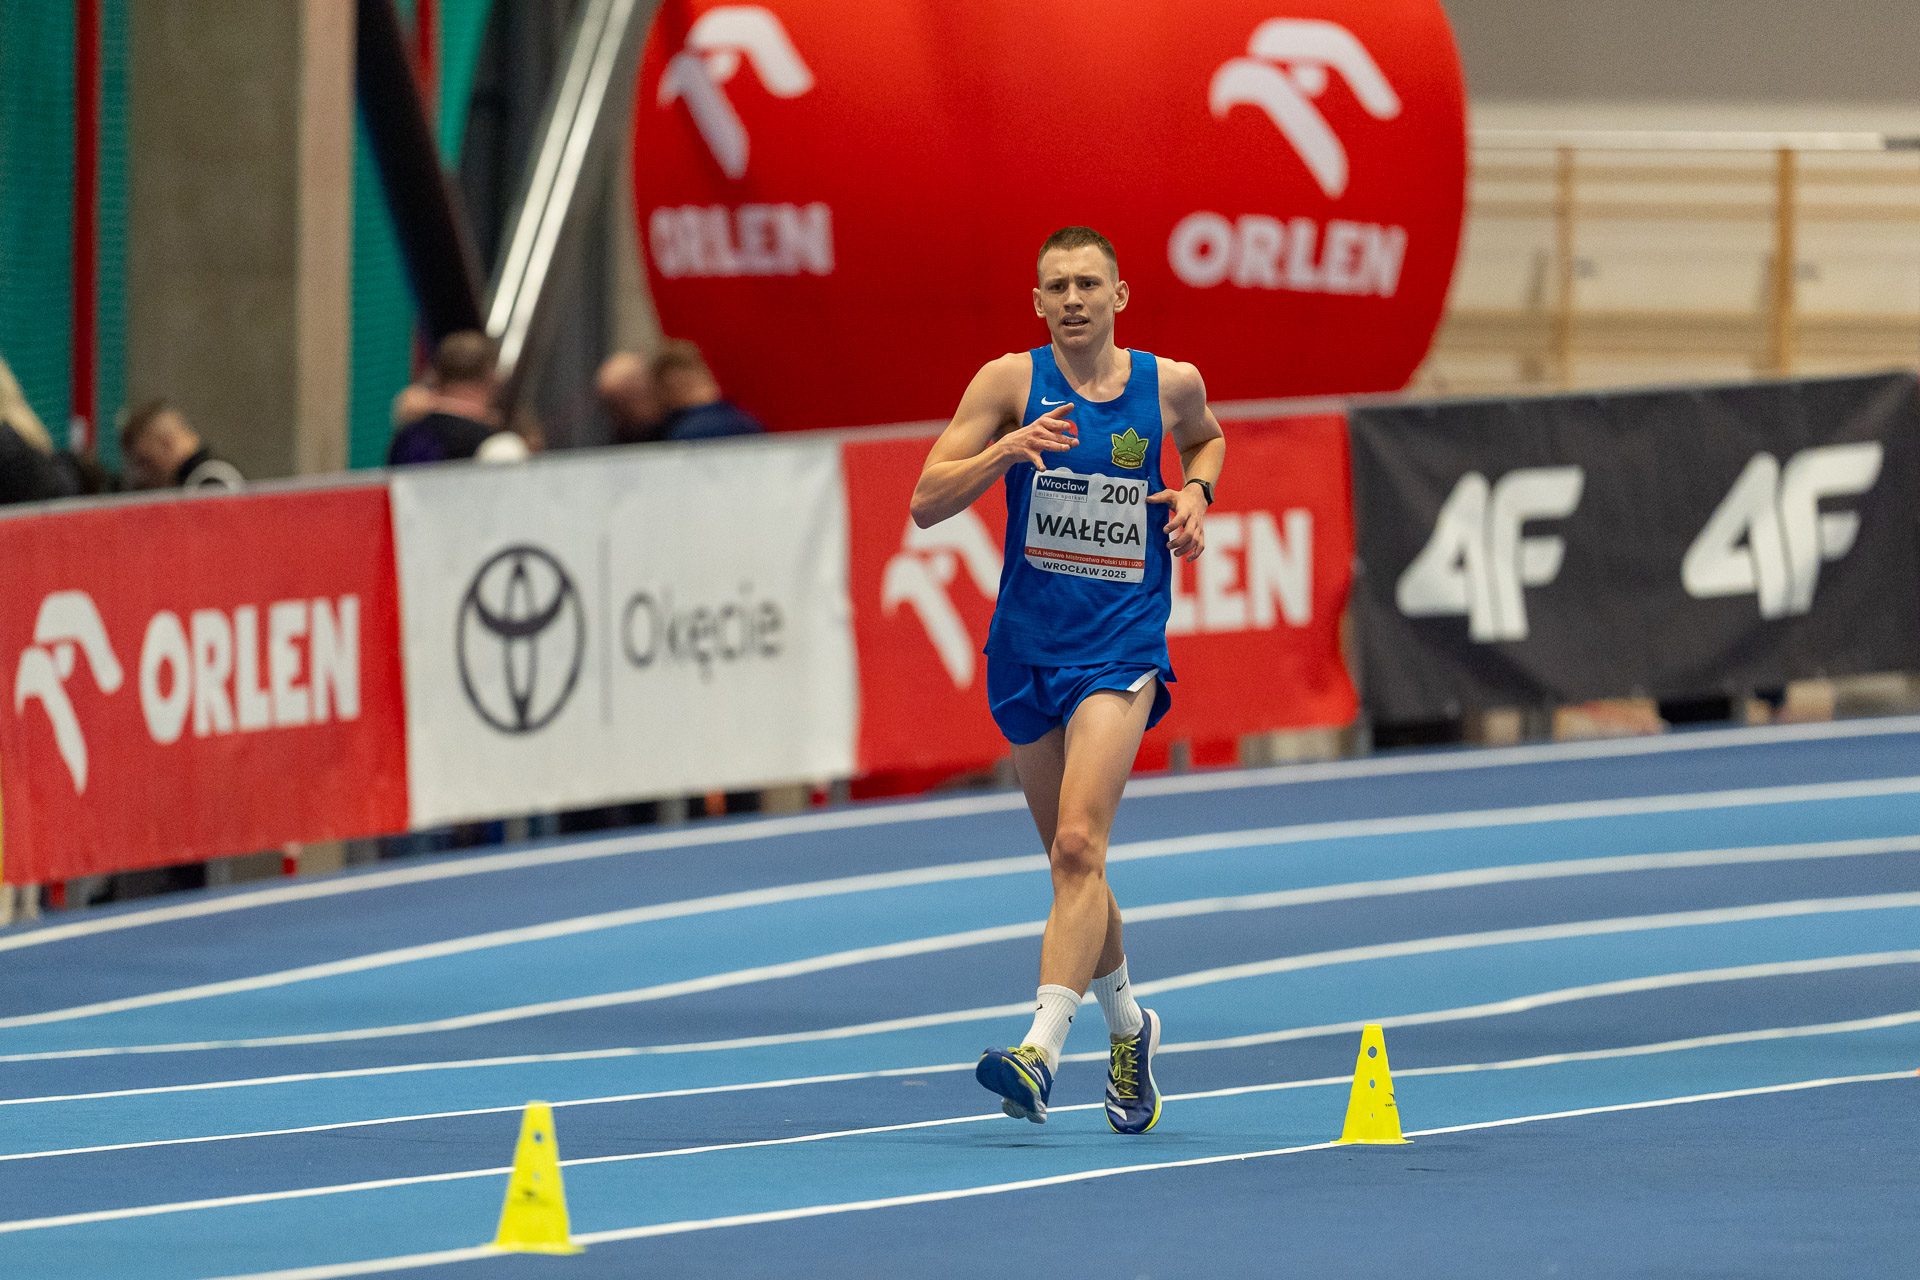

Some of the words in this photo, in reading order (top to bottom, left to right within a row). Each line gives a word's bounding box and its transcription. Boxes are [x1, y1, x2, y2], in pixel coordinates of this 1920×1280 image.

[649, 203, 833, 279] ORLEN
[1169, 212, 1407, 298] ORLEN
[1040, 477, 1087, 492] Wrocław
[1100, 484, 1140, 505] 200
[1028, 548, 1042, 556] PZLA
[1042, 551, 1065, 559] Halowe
[1065, 553, 1100, 564] Mistrzostwa
[1100, 558, 1118, 566] Polski
[1036, 513, 1141, 547] WAŁĘGA
[1042, 561, 1100, 576] WROCŁAW
[1101, 569, 1127, 579] 2025
[1396, 465, 1585, 642] 4F
[1681, 441, 1884, 620] 4F
[1165, 508, 1313, 637] LEN
[139, 594, 361, 744] ORLEN
[621, 583, 784, 681] Okęcie
